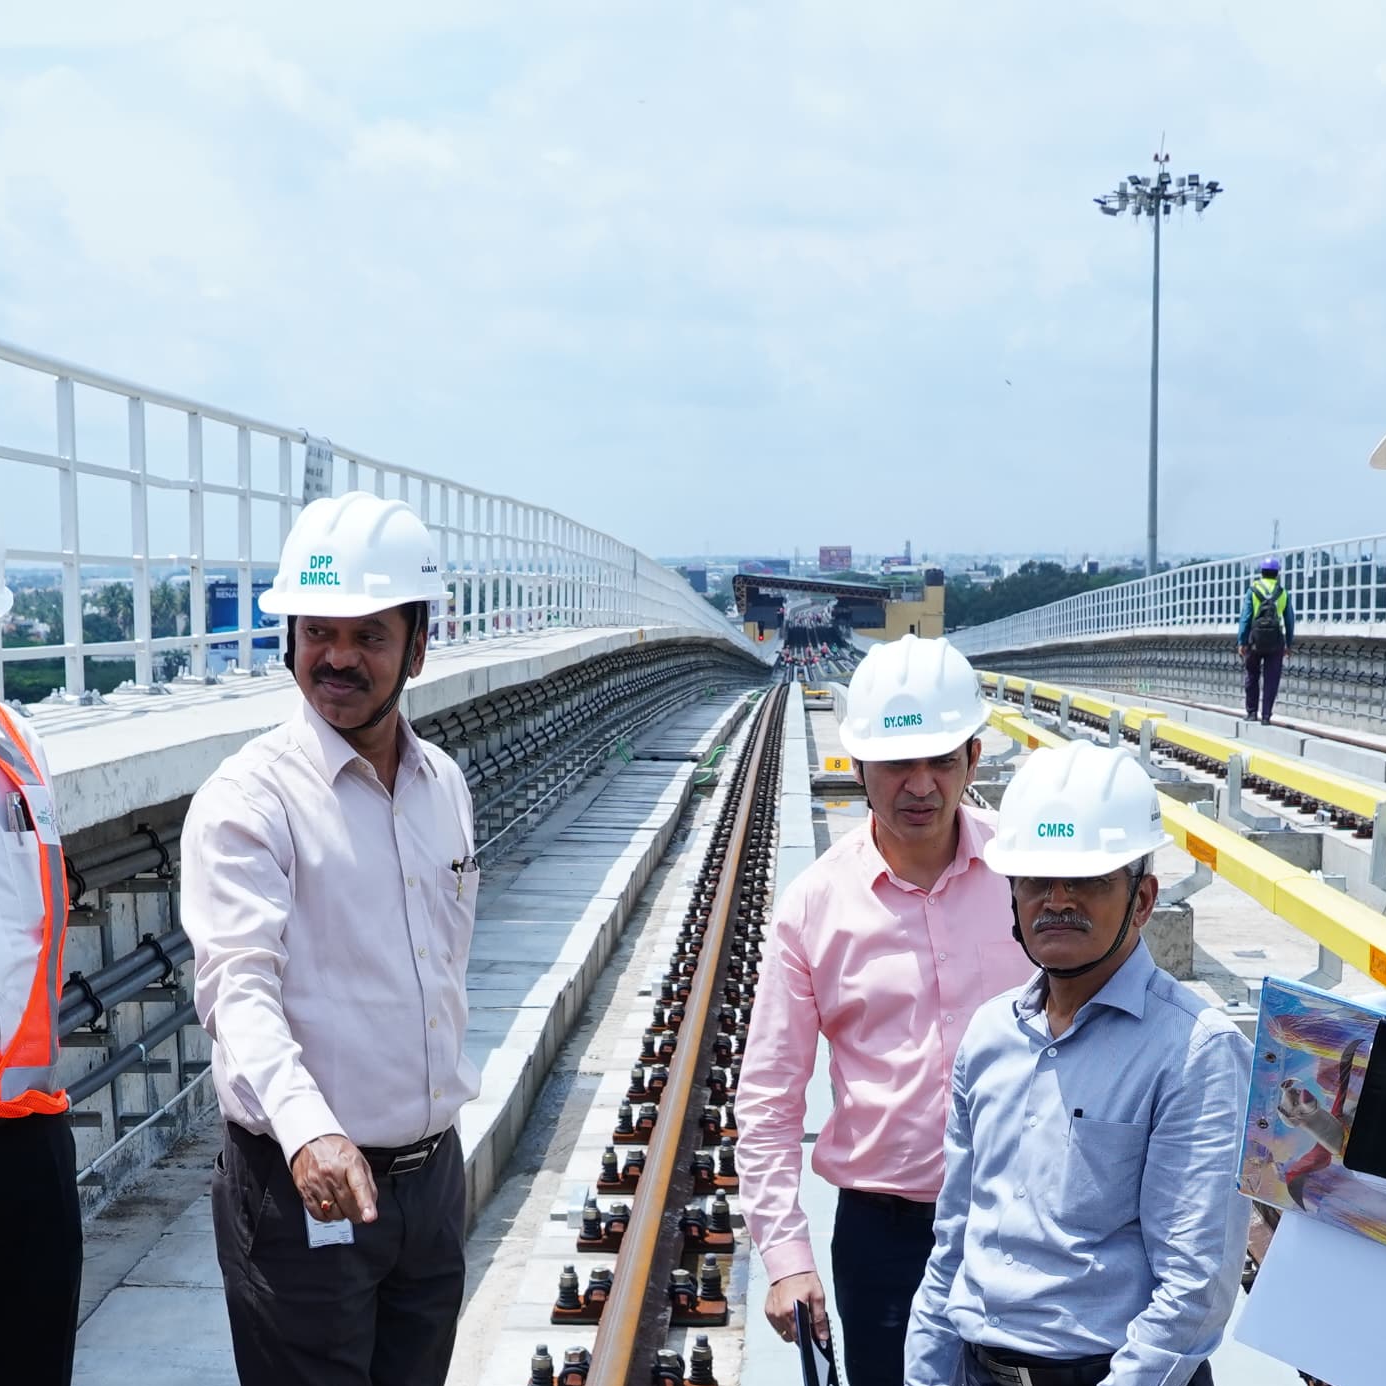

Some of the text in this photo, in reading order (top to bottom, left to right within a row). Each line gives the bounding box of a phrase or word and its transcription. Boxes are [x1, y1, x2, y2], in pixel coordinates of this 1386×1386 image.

[310, 555, 333, 569] DPP
[300, 571, 340, 585] BMRCL
[884, 713, 923, 729] DY.CMRS
[834, 759, 841, 769] 8
[1037, 823, 1075, 837] CMRS
